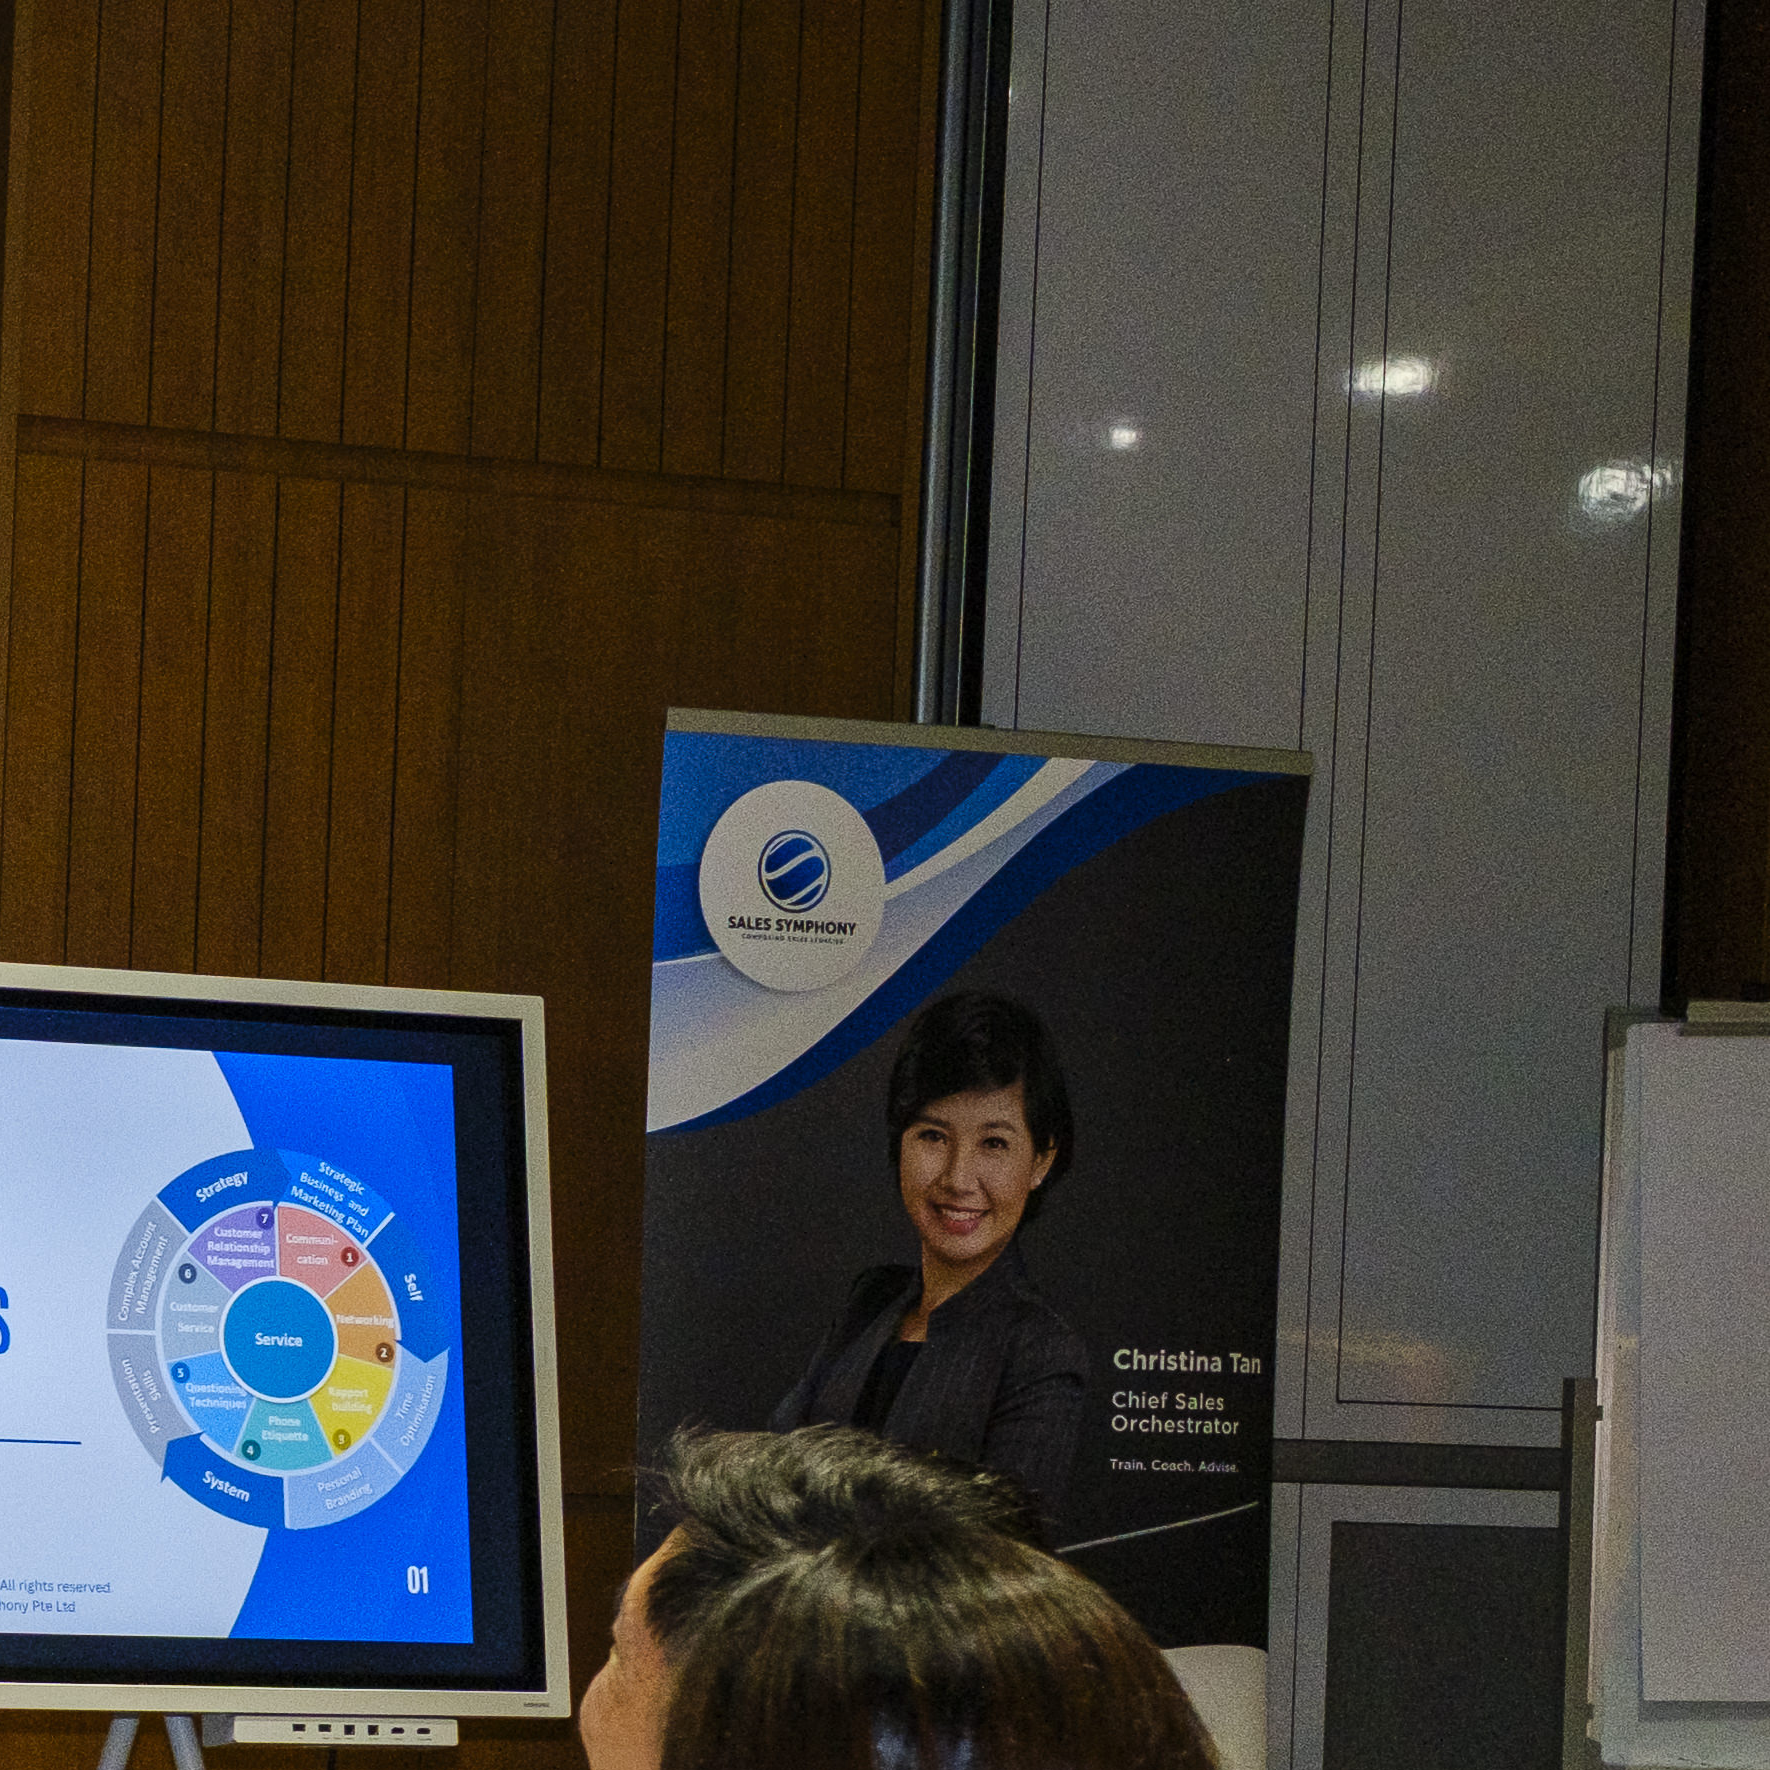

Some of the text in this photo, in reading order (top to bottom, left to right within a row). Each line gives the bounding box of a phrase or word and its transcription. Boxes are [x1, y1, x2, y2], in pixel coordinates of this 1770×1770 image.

[728, 916, 856, 936] SALES SYMPHONY
[195, 1170, 250, 1203] Strategy
[318, 1161, 365, 1195] Strategic
[299, 1172, 369, 1218] Business and
[290, 1185, 370, 1239] Marketing Plan
[213, 1227, 264, 1240] Customer
[207, 1241, 271, 1256] Relationship
[206, 1255, 275, 1269] Management
[297, 1254, 328, 1266] cation
[118, 1221, 157, 1322] Complex Account
[135, 1236, 168, 1315] Management
[404, 1273, 423, 1302] Self
[170, 1302, 219, 1313] Customer
[177, 1322, 215, 1334] Service
[336, 1314, 396, 1329] Networking
[255, 1332, 303, 1348] Service
[1113, 1348, 1261, 1374] Christina Tan
[143, 1370, 161, 1400] Skills
[185, 1382, 247, 1398] Questioning
[329, 1387, 369, 1400] Rapport
[122, 1359, 160, 1435] Presentation
[189, 1396, 247, 1411] Techniques
[395, 1391, 414, 1420] Time
[1112, 1390, 1224, 1411] Chief Sales
[331, 1402, 372, 1415] building
[400, 1375, 437, 1447] Optimisation
[268, 1416, 300, 1427] Phone
[1111, 1414, 1240, 1435] Orchestrator
[262, 1430, 309, 1443] Etiquette
[1110, 1459, 1146, 1471] Train.
[1151, 1460, 1194, 1472] Coach.
[202, 1470, 251, 1502] System
[317, 1467, 362, 1493] Personal
[325, 1483, 373, 1510] Branding
[0, 1579, 15, 1591] All
[19, 1580, 54, 1594] rights
[407, 1565, 429, 1594] 01
[32, 1600, 53, 1612] Pte
[56, 1601, 75, 1613] Ltd
